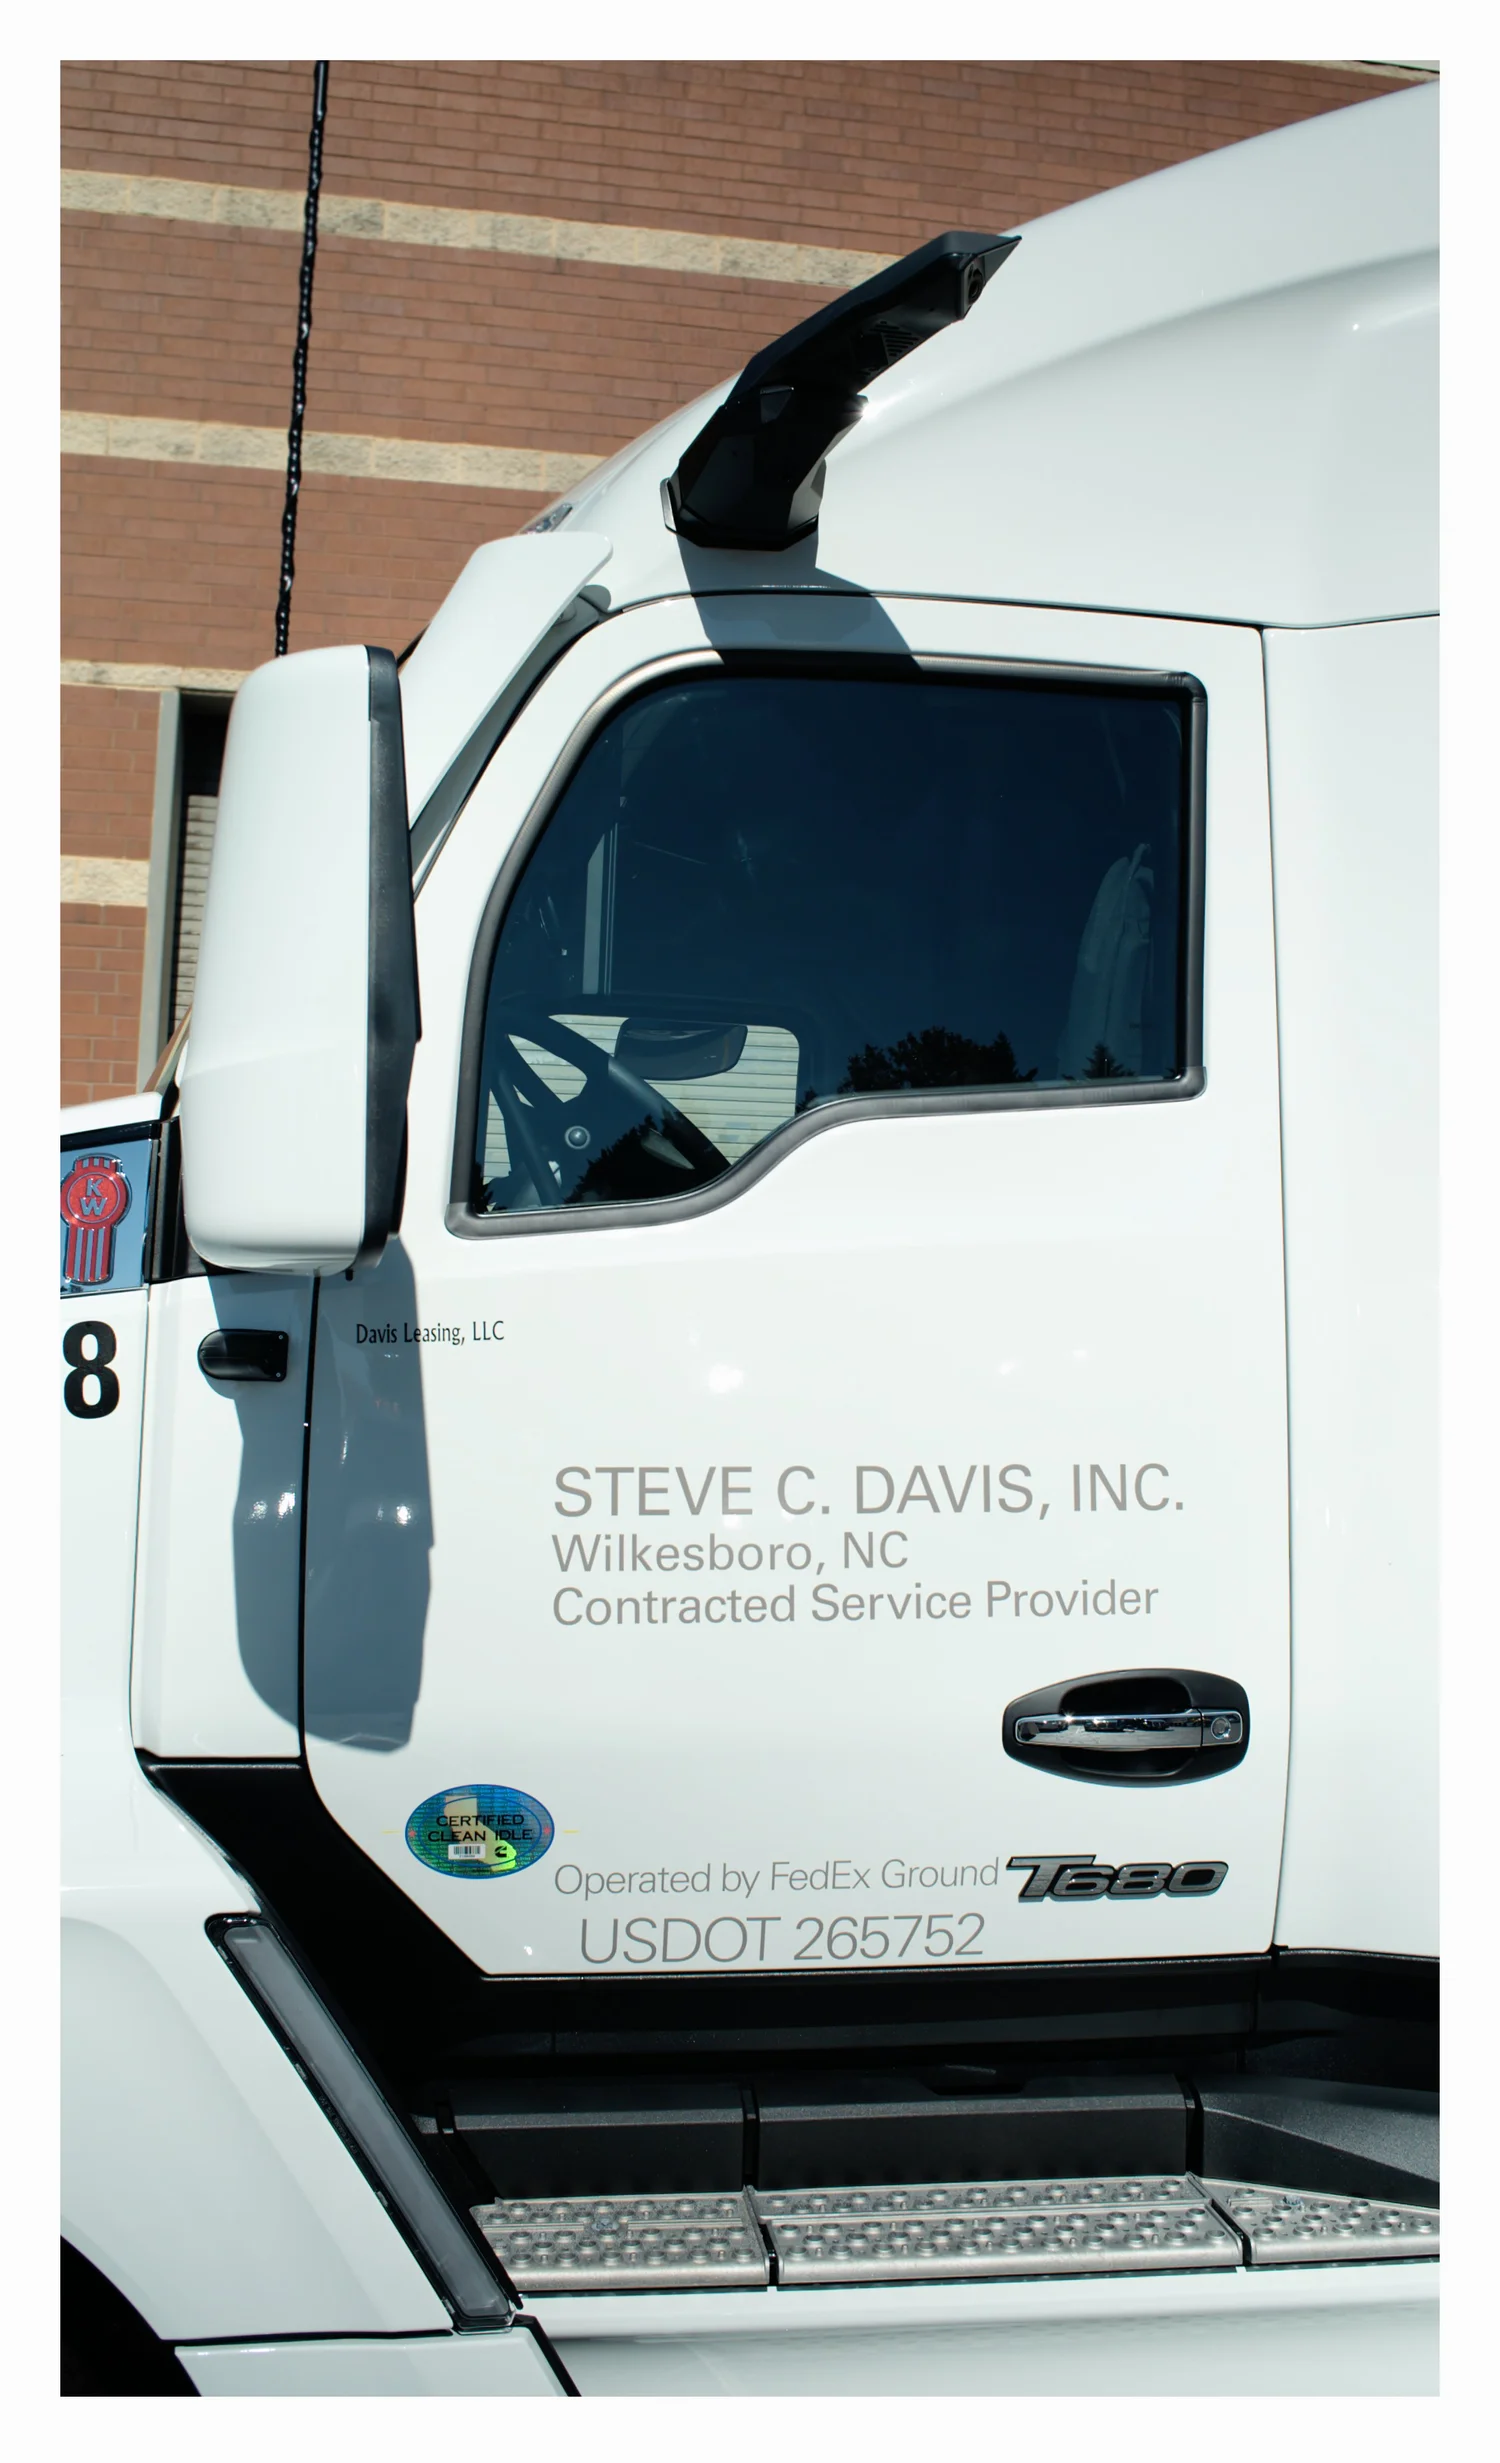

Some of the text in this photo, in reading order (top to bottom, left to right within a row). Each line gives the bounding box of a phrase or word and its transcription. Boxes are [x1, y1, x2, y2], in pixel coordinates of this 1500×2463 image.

[356, 1319, 505, 1346] Davis Leasing, LLC
[62, 1320, 121, 1420] 8
[554, 1462, 1185, 1521] STEVE C. DAVIS, INC.
[551, 1530, 909, 1576] Wilkesboro, NC
[552, 1578, 1160, 1626] Contracted Service Provider
[428, 1828, 533, 1842] CLEAN IDLE
[436, 1814, 525, 1827] CERTIFIED
[553, 1856, 1000, 1902] Operated by FedEx Ground
[1006, 1854, 1229, 1902] T680
[580, 1912, 986, 1965] USDOT 265752
